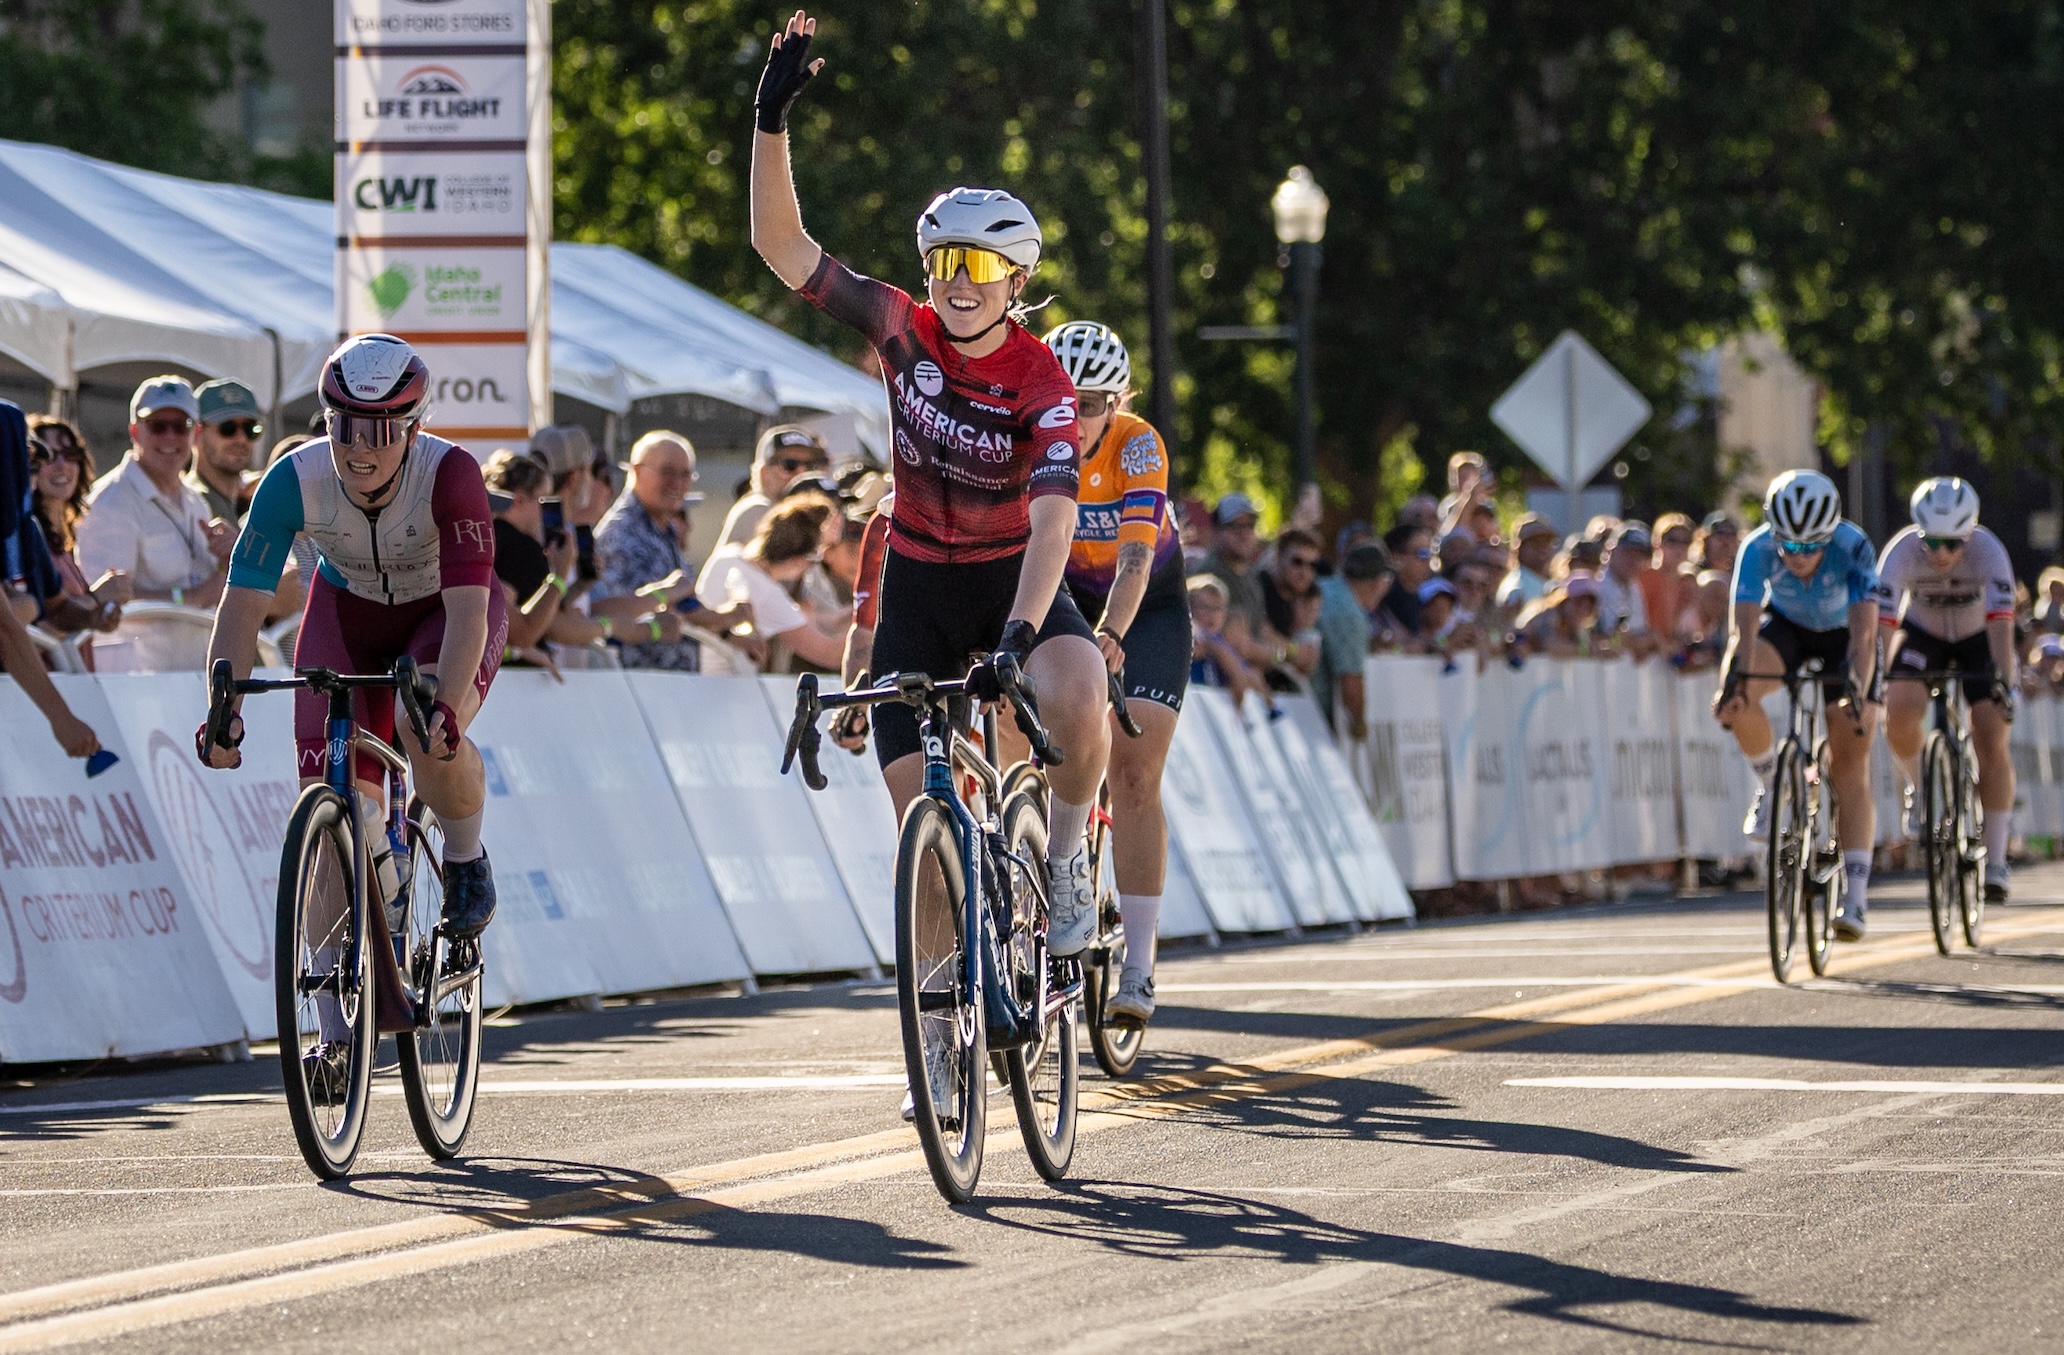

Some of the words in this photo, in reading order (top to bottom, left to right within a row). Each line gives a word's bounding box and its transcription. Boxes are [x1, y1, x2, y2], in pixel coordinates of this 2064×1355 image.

[404, 13, 447, 32] FORD
[449, 13, 514, 32] STORES
[364, 98, 411, 118] LIFE
[420, 97, 501, 118] FLIGHT
[354, 177, 437, 211] CWI
[425, 264, 482, 284] Idaho
[424, 284, 501, 303] Central
[430, 378, 507, 403] ron
[894, 372, 1012, 451] AMERICAN
[970, 400, 1012, 416] cervélo
[896, 394, 972, 457] CRITERIUM
[979, 449, 1013, 463] CUP
[0, 791, 156, 870] AMERICAN
[22, 895, 136, 943] CRITERIUM
[128, 886, 180, 937] CUP
